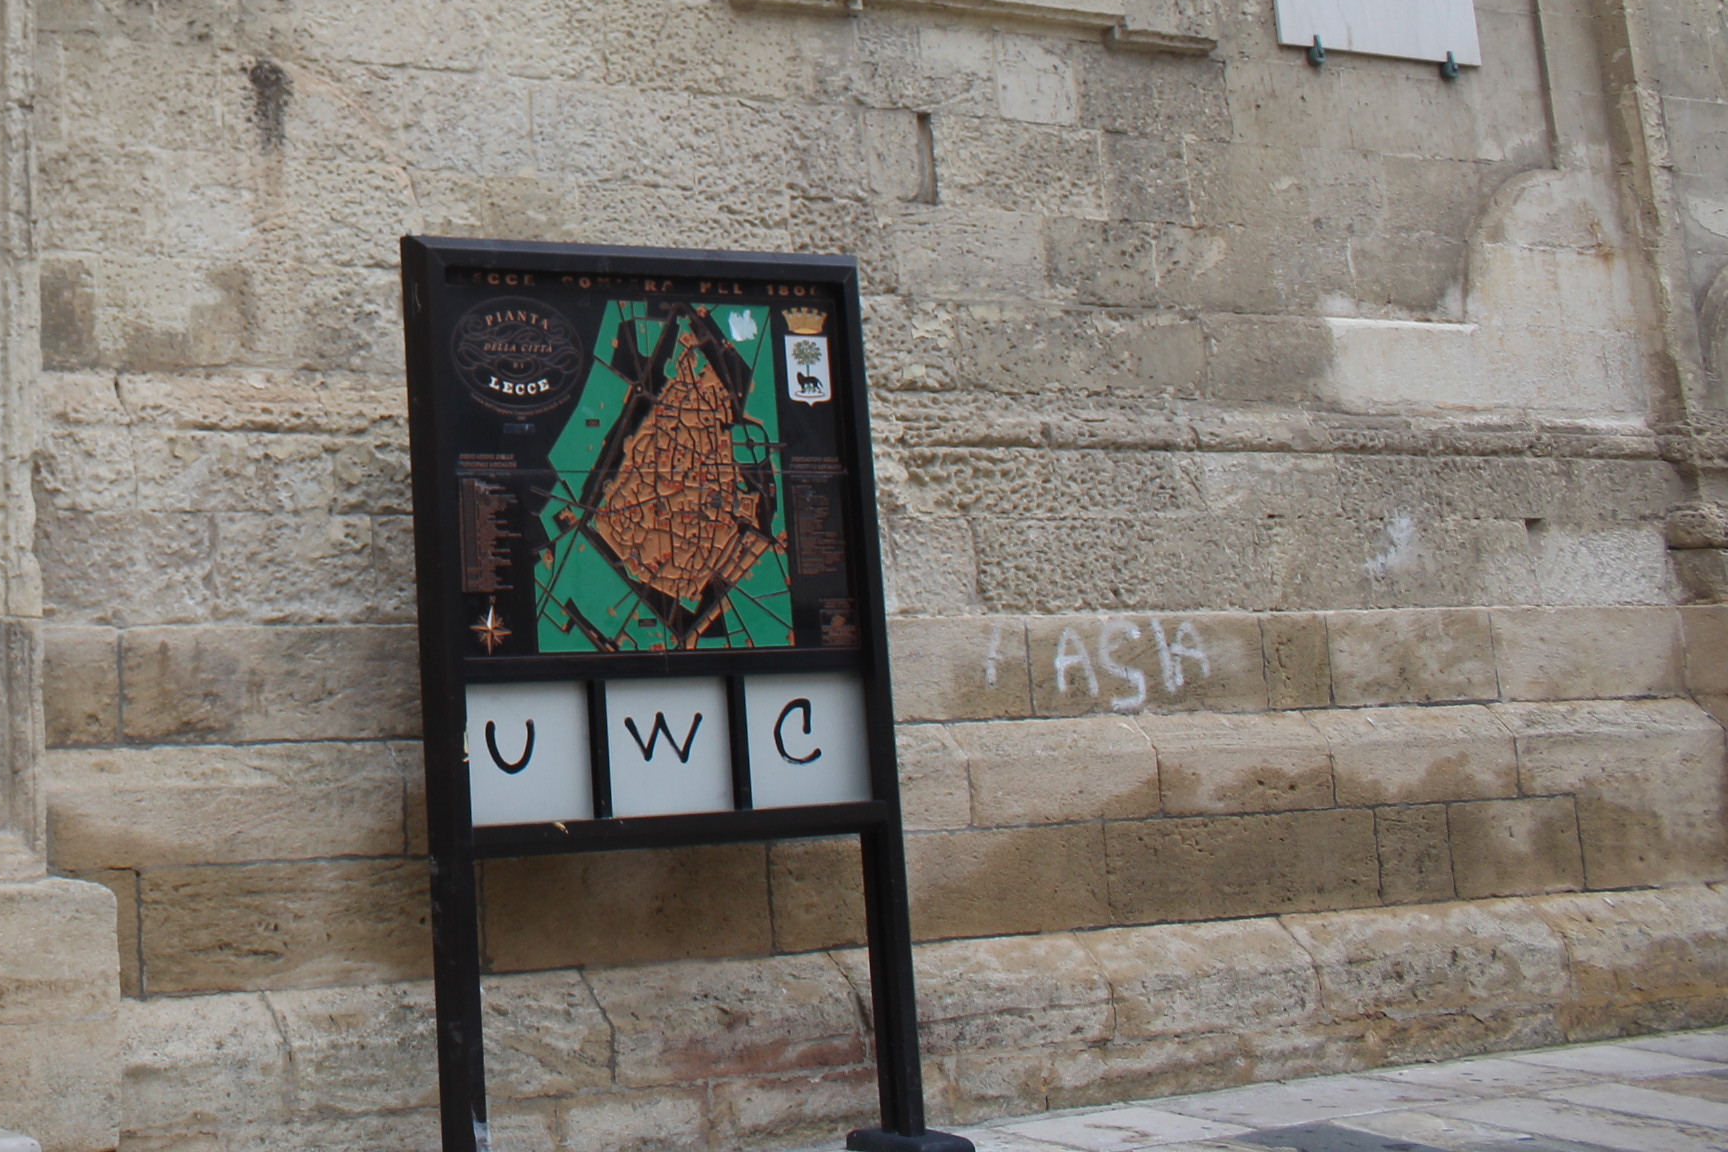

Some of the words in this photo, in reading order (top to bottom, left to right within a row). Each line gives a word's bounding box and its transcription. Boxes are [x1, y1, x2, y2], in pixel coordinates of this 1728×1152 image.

[485, 310, 550, 330] PIANTA
[483, 343, 516, 352] DELLA
[521, 342, 553, 353] CITTÀ
[489, 376, 550, 395] LECCE
[485, 720, 535, 774] U
[624, 711, 703, 764] W
[774, 698, 822, 765] C
